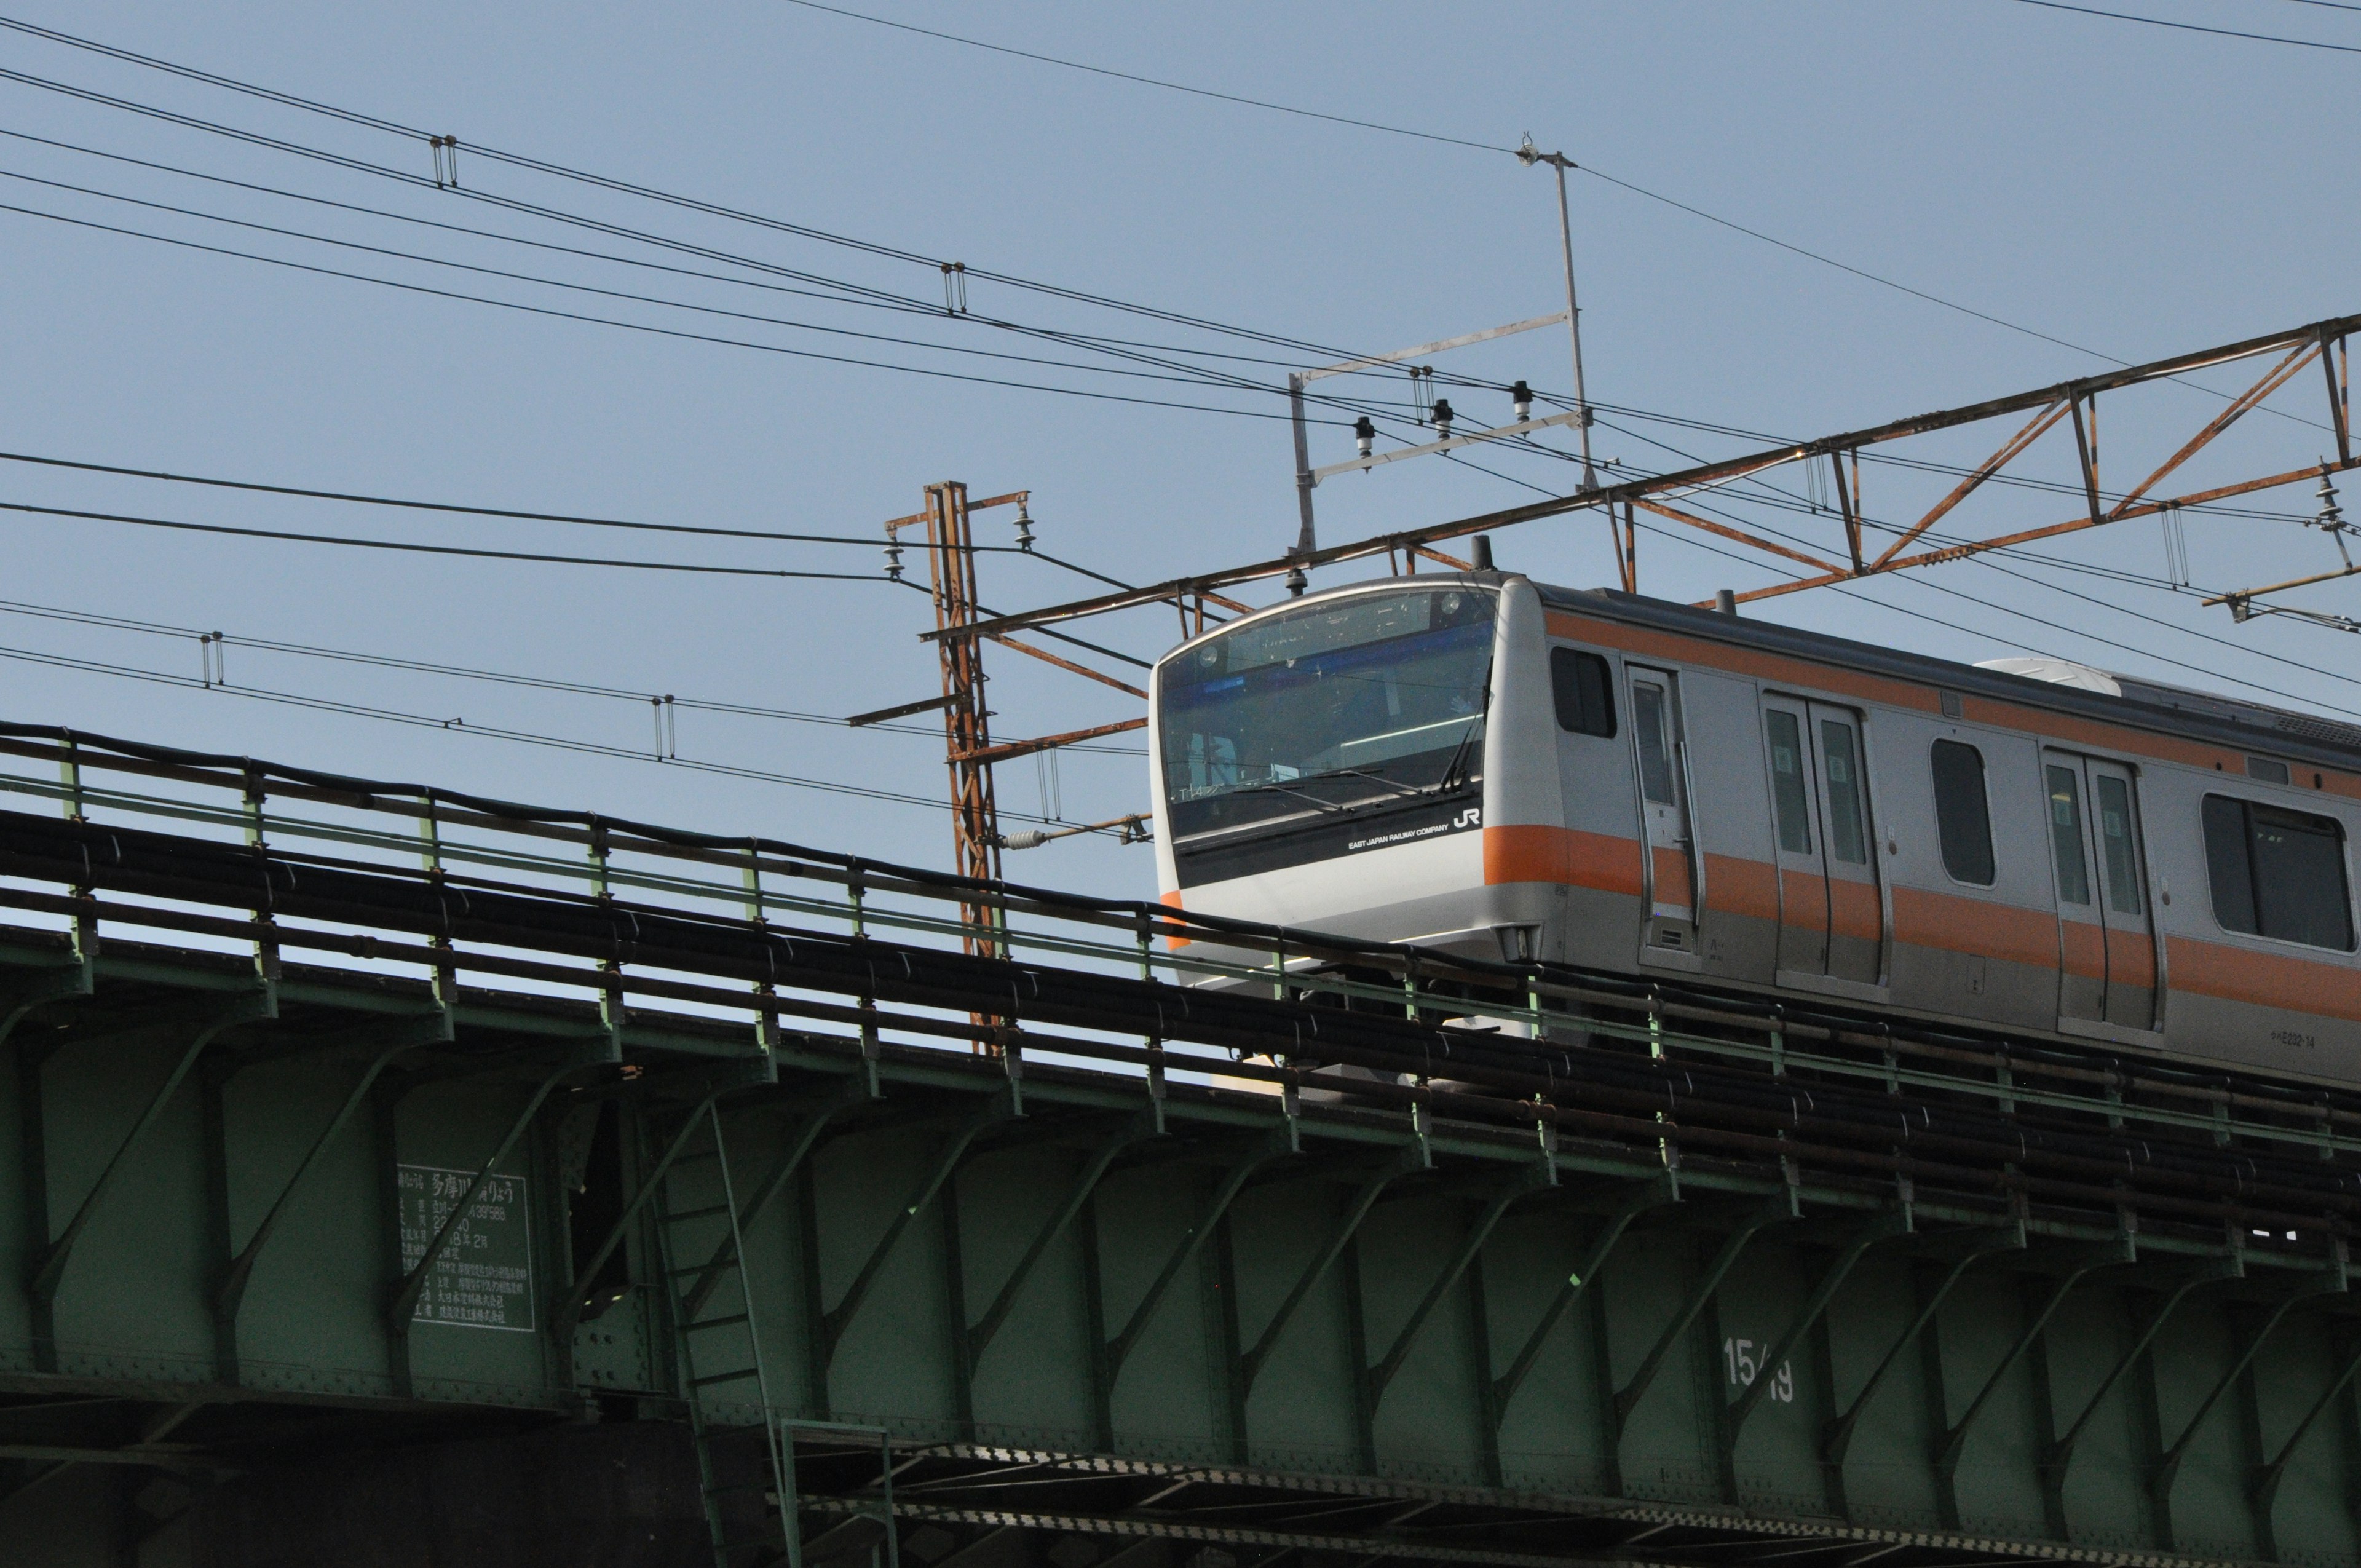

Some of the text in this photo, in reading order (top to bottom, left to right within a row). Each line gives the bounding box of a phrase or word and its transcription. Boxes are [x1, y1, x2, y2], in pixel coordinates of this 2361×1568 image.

[1453, 807, 1481, 828] JR
[1348, 823, 1449, 850] EAST JAPAN RAILWAY COMPANY
